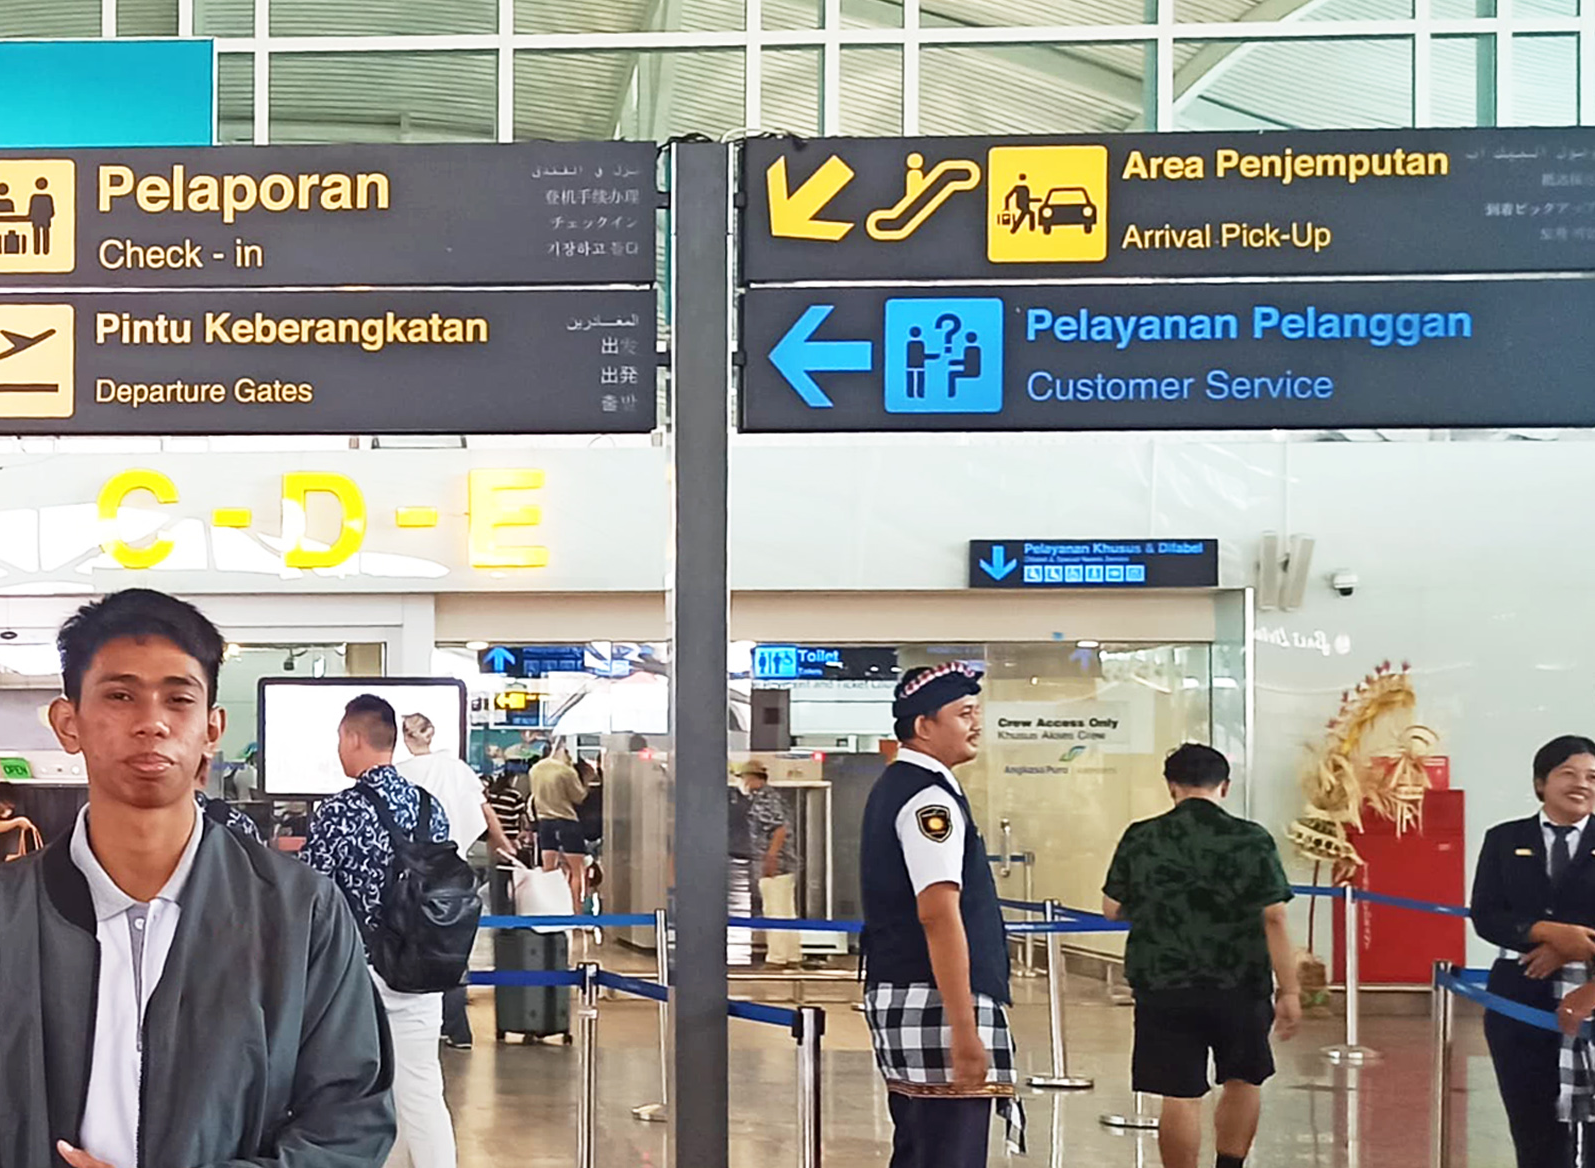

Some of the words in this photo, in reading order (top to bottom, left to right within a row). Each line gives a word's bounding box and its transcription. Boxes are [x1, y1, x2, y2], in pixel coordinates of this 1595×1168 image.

[1122, 150, 1205, 180] Area
[1215, 148, 1450, 189] Penjemputan
[97, 165, 390, 223] Pelaporan
[552, 215, 638, 230] チェックイン
[1120, 221, 1211, 250] Arrival
[1222, 220, 1332, 252] Pick-Up
[98, 237, 203, 268] Check
[235, 238, 264, 268] in
[96, 311, 192, 344] Pintu
[204, 311, 490, 351] Keberangkatan
[1025, 307, 1238, 350] Pelayanan
[1252, 306, 1473, 347] Pelanggan
[600, 365, 639, 384] 出発
[1026, 370, 1194, 401] Customer
[1207, 369, 1334, 401] Service
[96, 378, 226, 408] Departure
[233, 377, 313, 405] Gates
[96, 468, 180, 570] C
[282, 470, 366, 569] D
[467, 467, 550, 569] E
[1023, 542, 1090, 556] Pelayanan
[1092, 542, 1142, 554] Khusus
[797, 649, 840, 663] Toilet
[998, 717, 1032, 728] Crew
[1036, 717, 1085, 728] Access
[1088, 717, 1119, 729] Only
